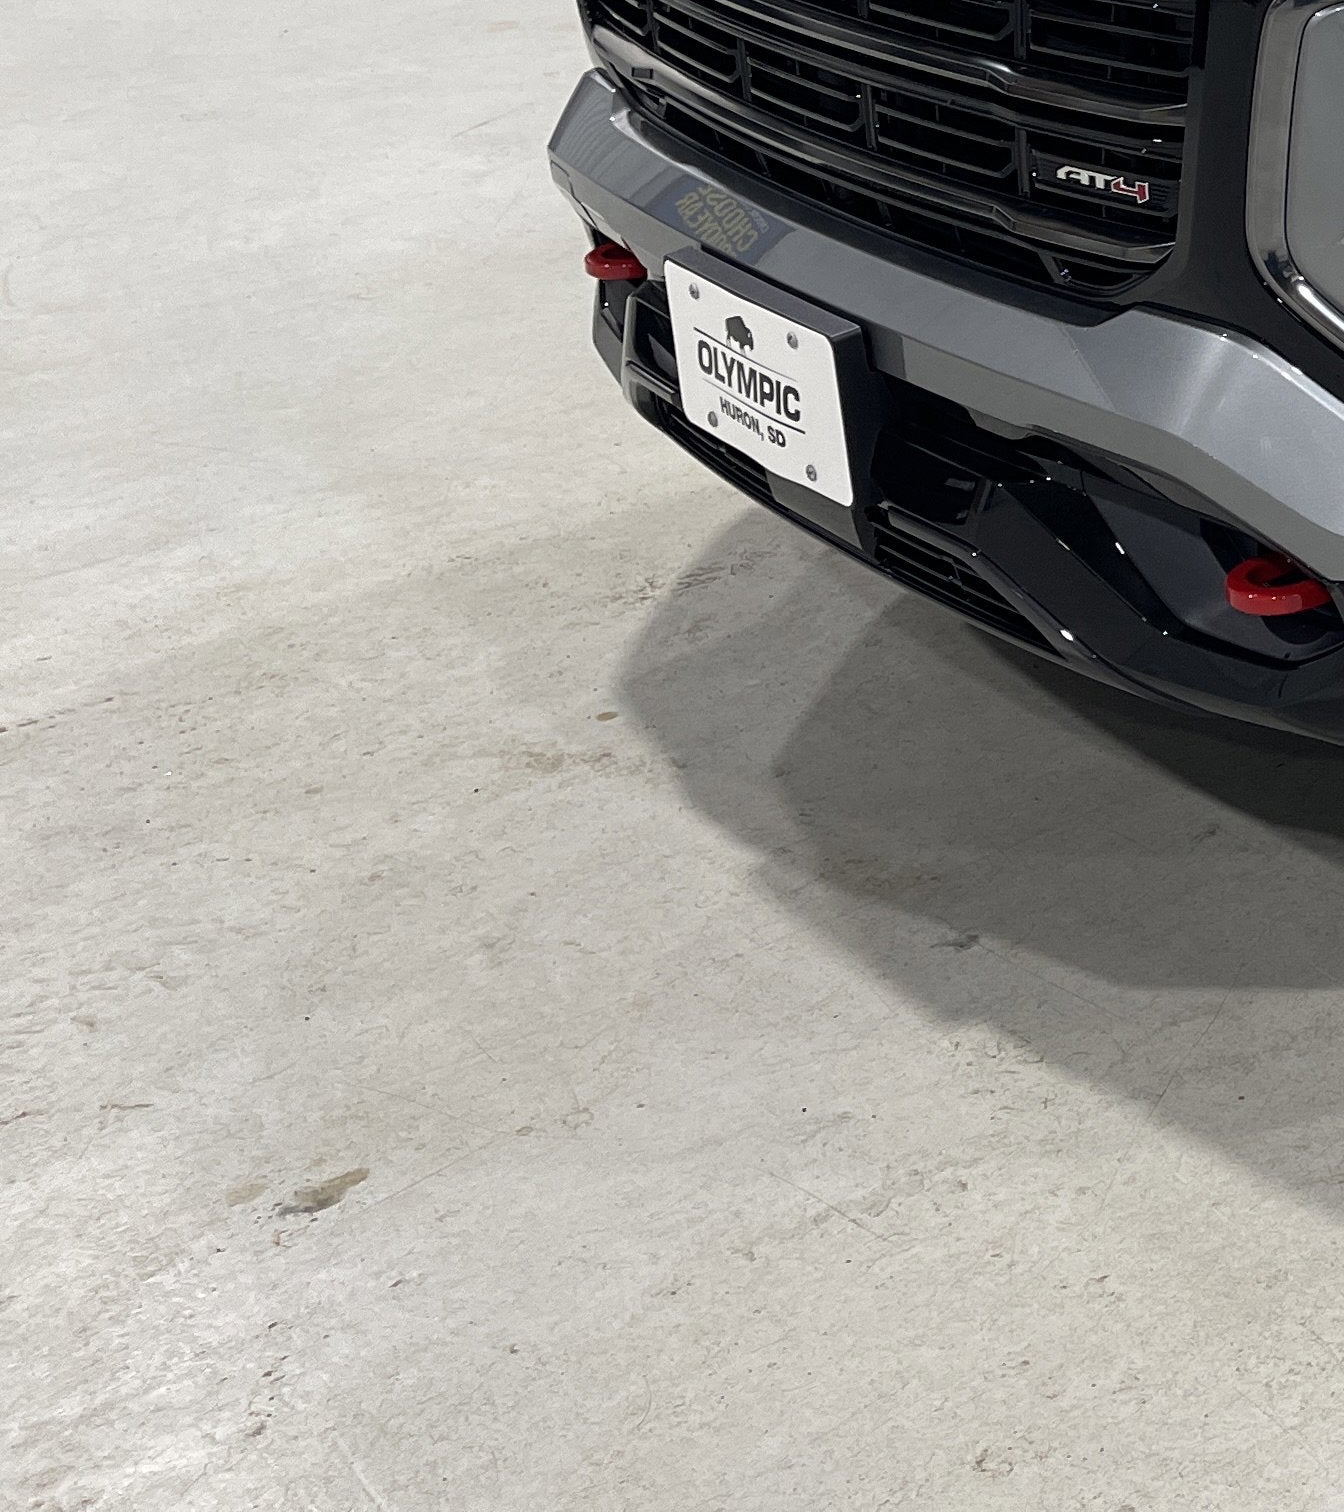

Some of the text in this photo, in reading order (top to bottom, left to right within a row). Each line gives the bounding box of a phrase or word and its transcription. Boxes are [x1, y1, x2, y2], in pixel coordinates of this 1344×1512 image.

[1056, 165, 1150, 205] AT4
[697, 339, 801, 423] OLYMPIC
[719, 396, 787, 449] HURON, SD
